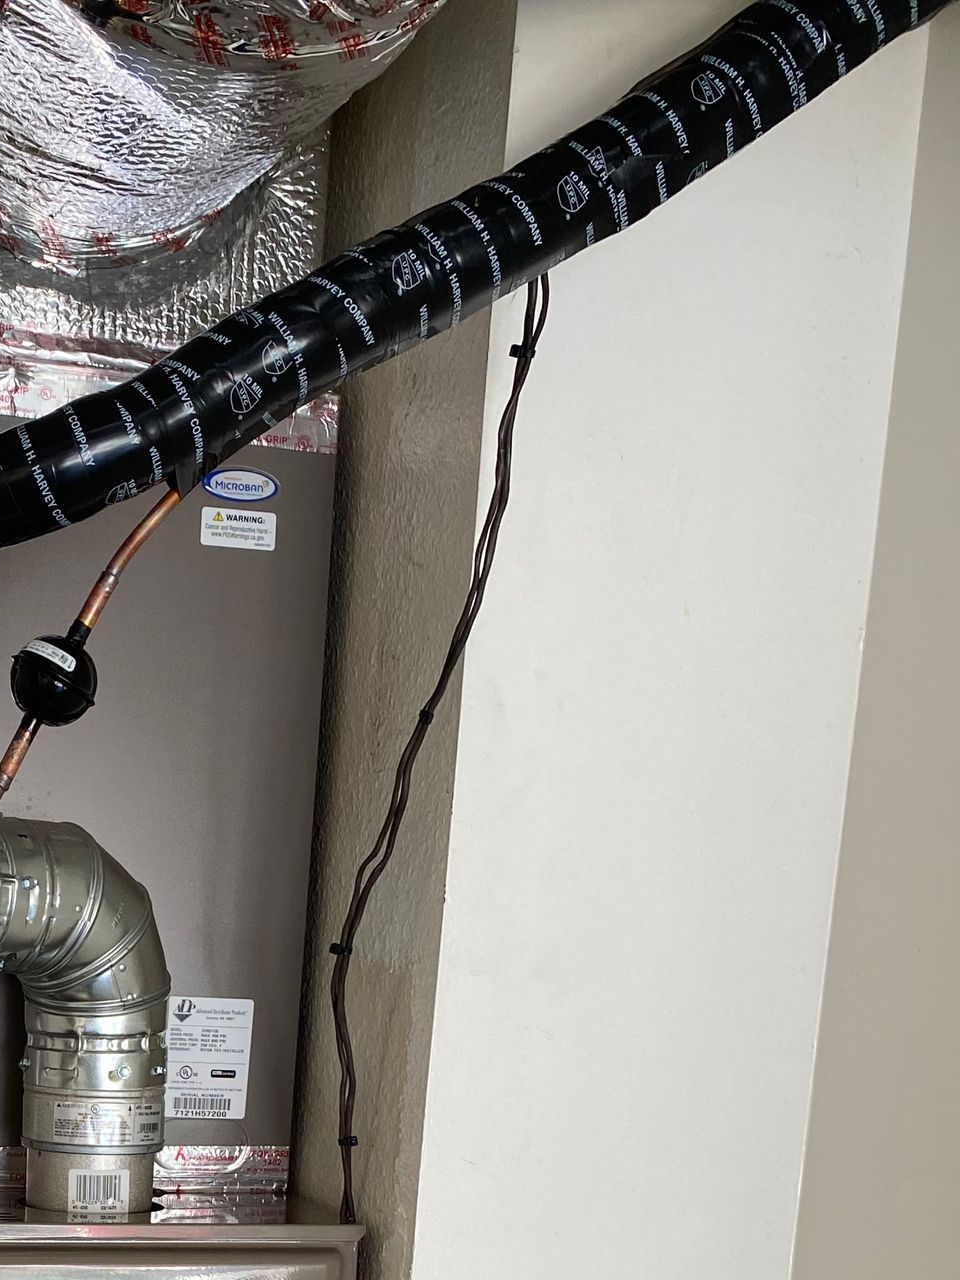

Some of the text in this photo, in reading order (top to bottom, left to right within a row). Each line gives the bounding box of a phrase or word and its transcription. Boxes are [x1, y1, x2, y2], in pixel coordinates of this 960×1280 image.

[701, 54, 763, 132] WILLIAM HARVEY
[666, 109, 689, 148] HARVEY
[568, 140, 602, 174] WILLIAM
[576, 180, 591, 200] MIL
[512, 194, 543, 247] COMPANY
[451, 199, 485, 233] WILLIAM
[487, 246, 501, 291] HARVEY
[414, 261, 426, 281] MIL
[415, 223, 462, 316] WILLIAM HARVEY
[308, 274, 375, 347] HARVEY COMPANY
[267, 311, 301, 356] WILLIAM
[239, 387, 249, 406] UPC
[242, 373, 264, 398] 10 MIL
[170, 373, 205, 465] HARVEY COMPANY
[68, 418, 96, 468] COMPANY
[32, 464, 54, 506] HARVEY
[225, 514, 266, 524] WARNING:
